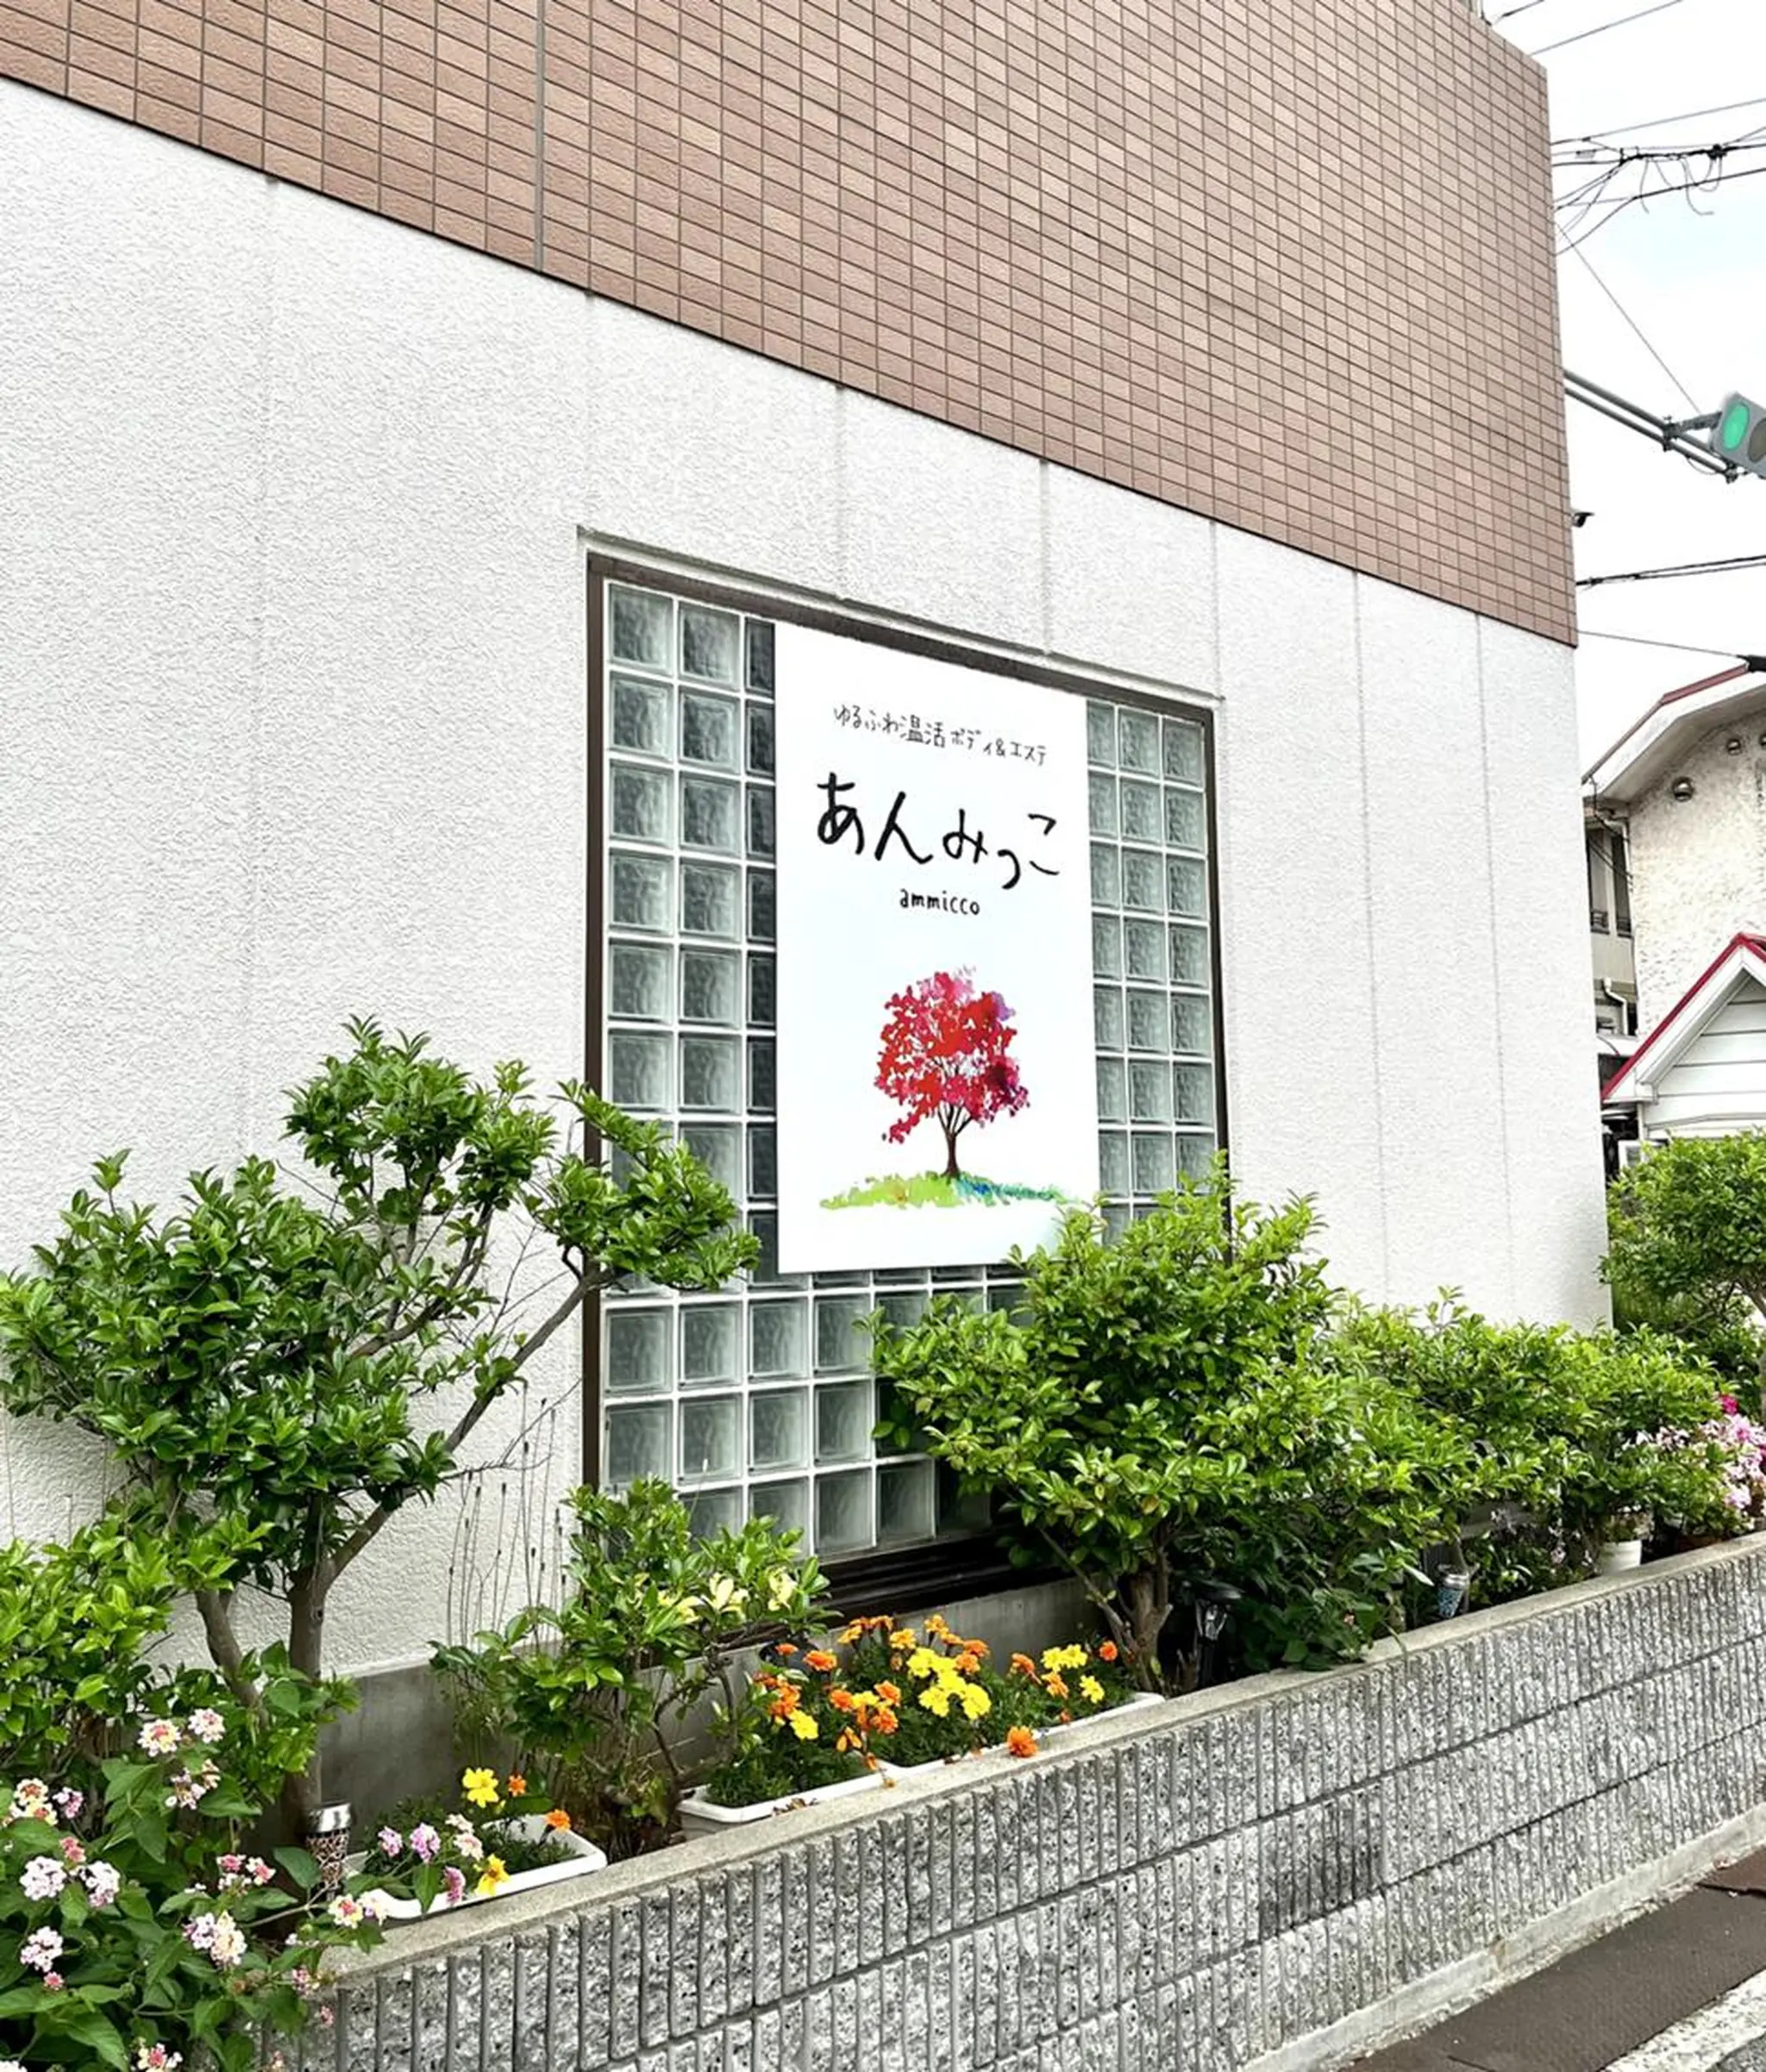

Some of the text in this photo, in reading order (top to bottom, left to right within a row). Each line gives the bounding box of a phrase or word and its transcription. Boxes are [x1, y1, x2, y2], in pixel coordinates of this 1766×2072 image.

[817, 772, 1060, 890] あんみっこ
[899, 889, 980, 916] ammicco
